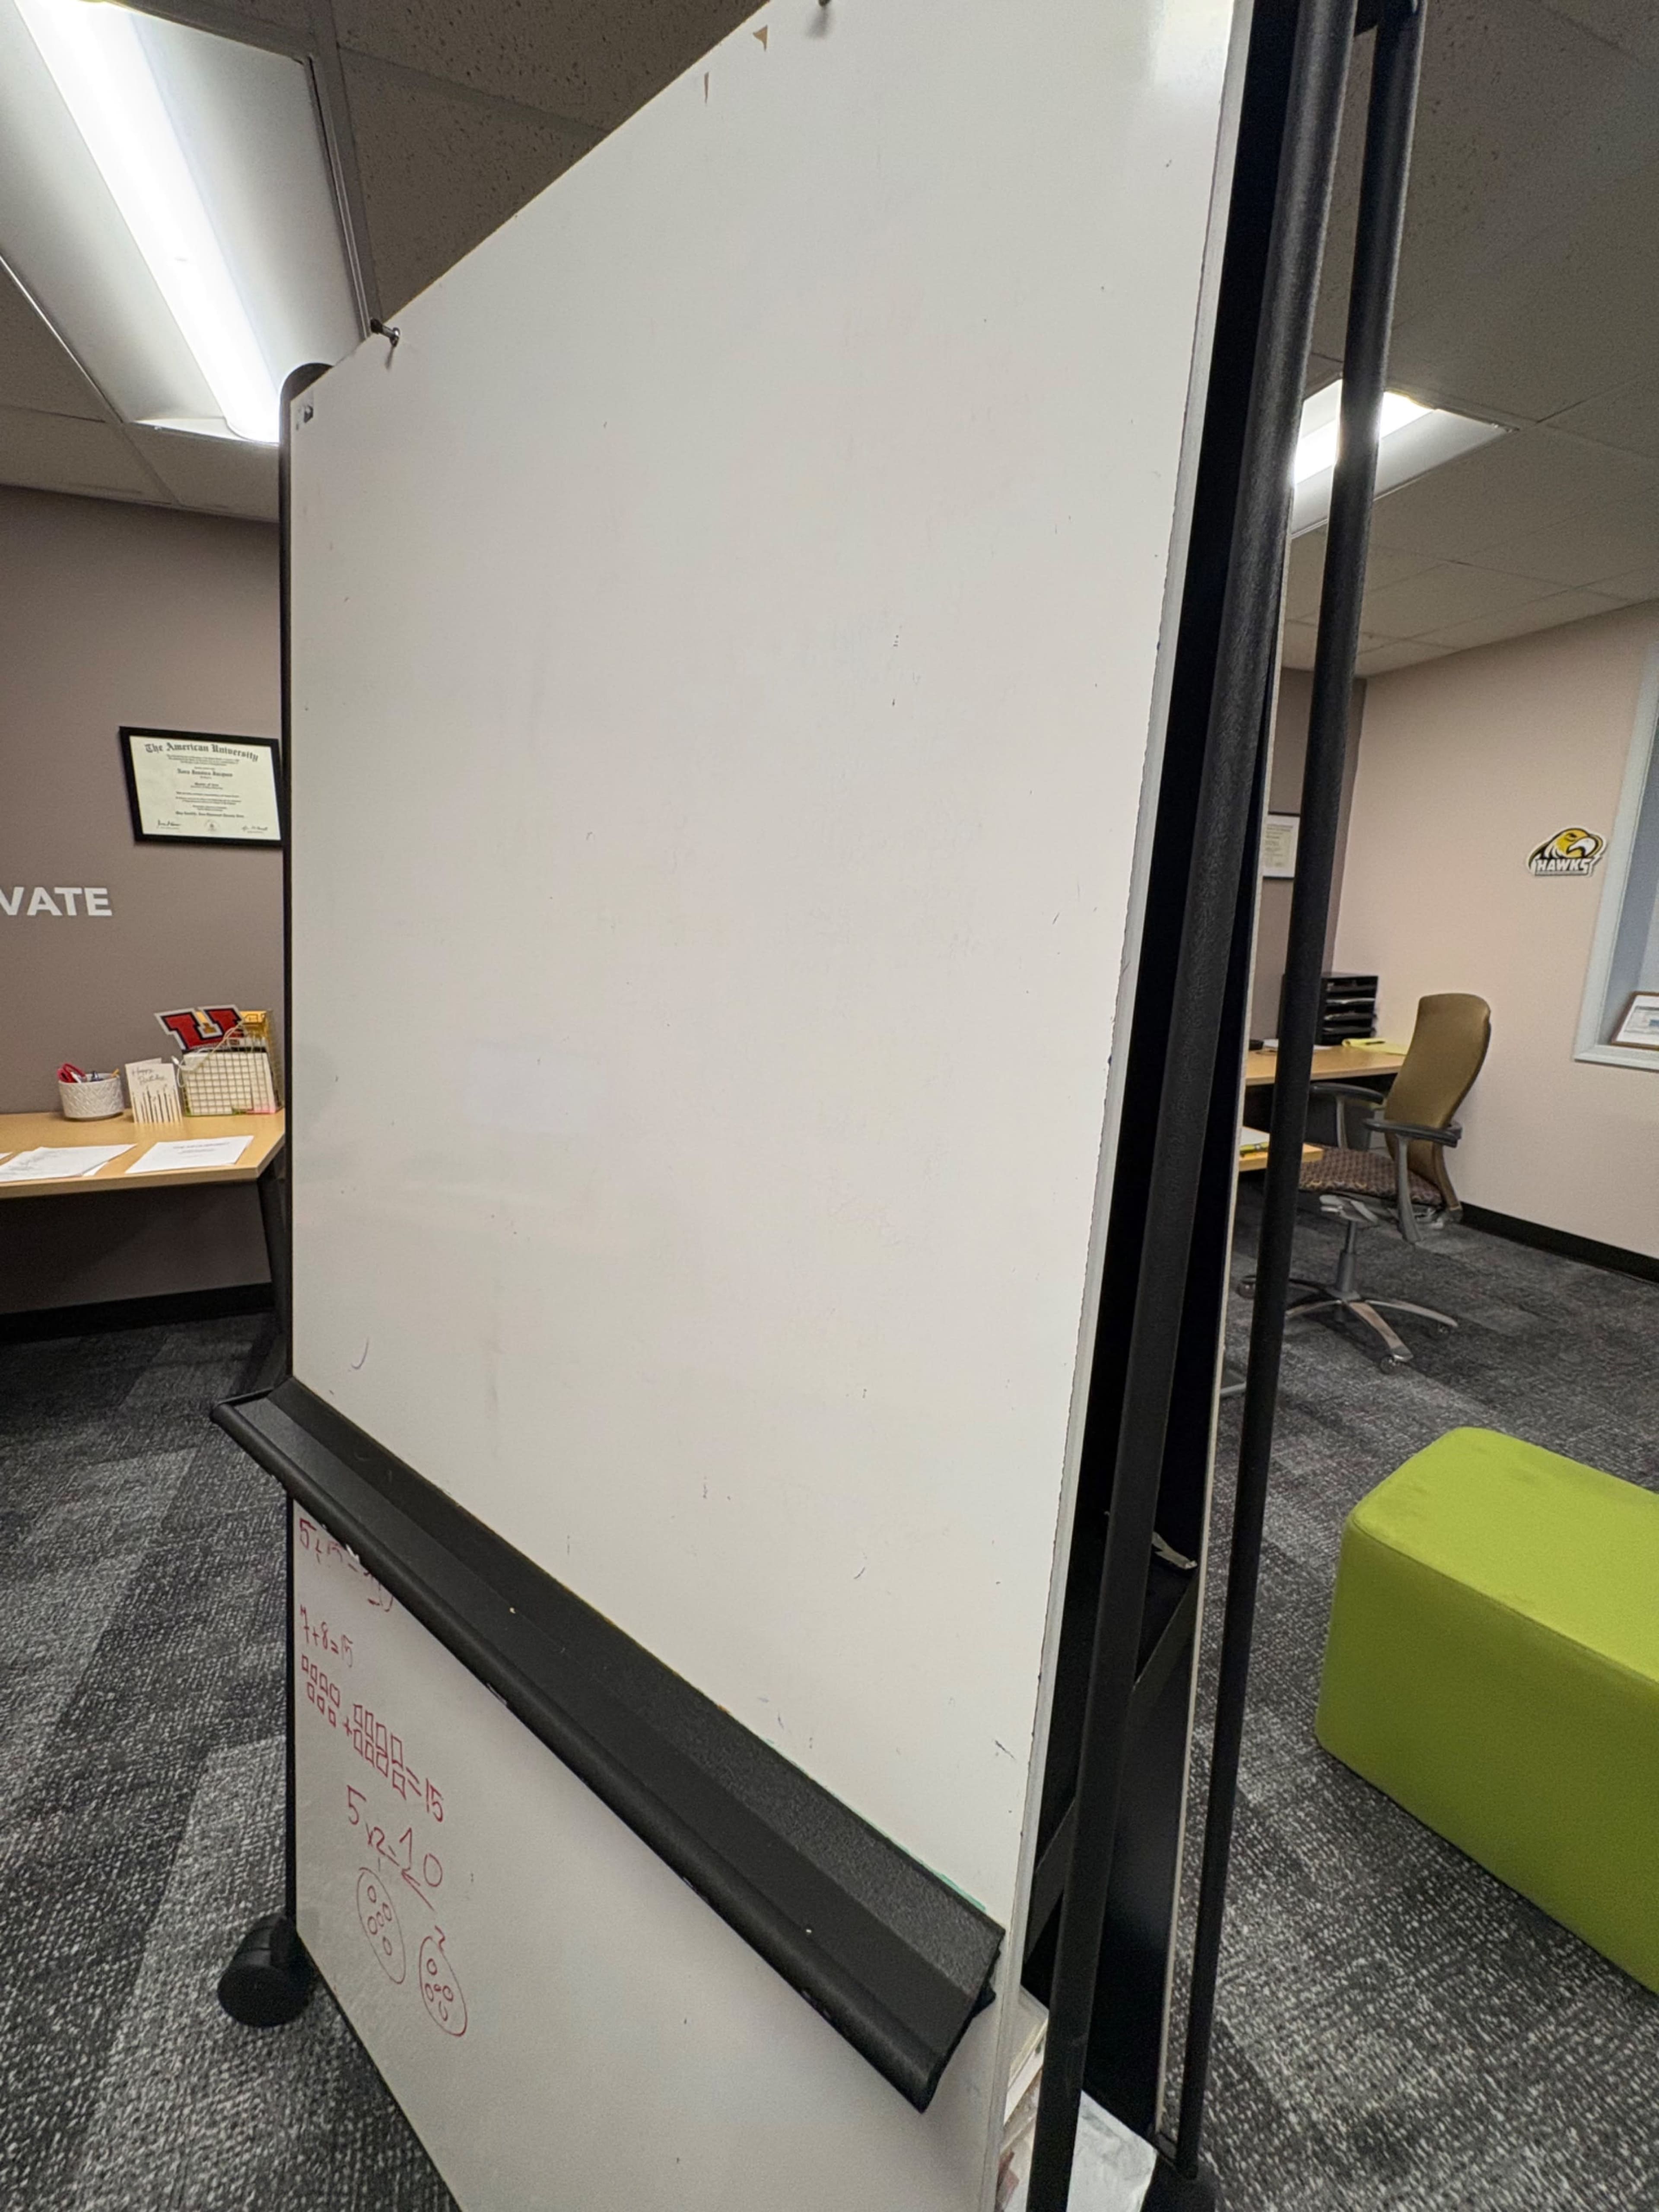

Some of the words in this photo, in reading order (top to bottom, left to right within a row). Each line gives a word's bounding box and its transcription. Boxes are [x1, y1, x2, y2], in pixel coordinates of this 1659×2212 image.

[145, 743, 163, 753] The
[166, 742, 209, 752] American
[211, 744, 259, 763] University
[1536, 858, 1592, 874] HAWKS
[0, 887, 112, 916] VATE
